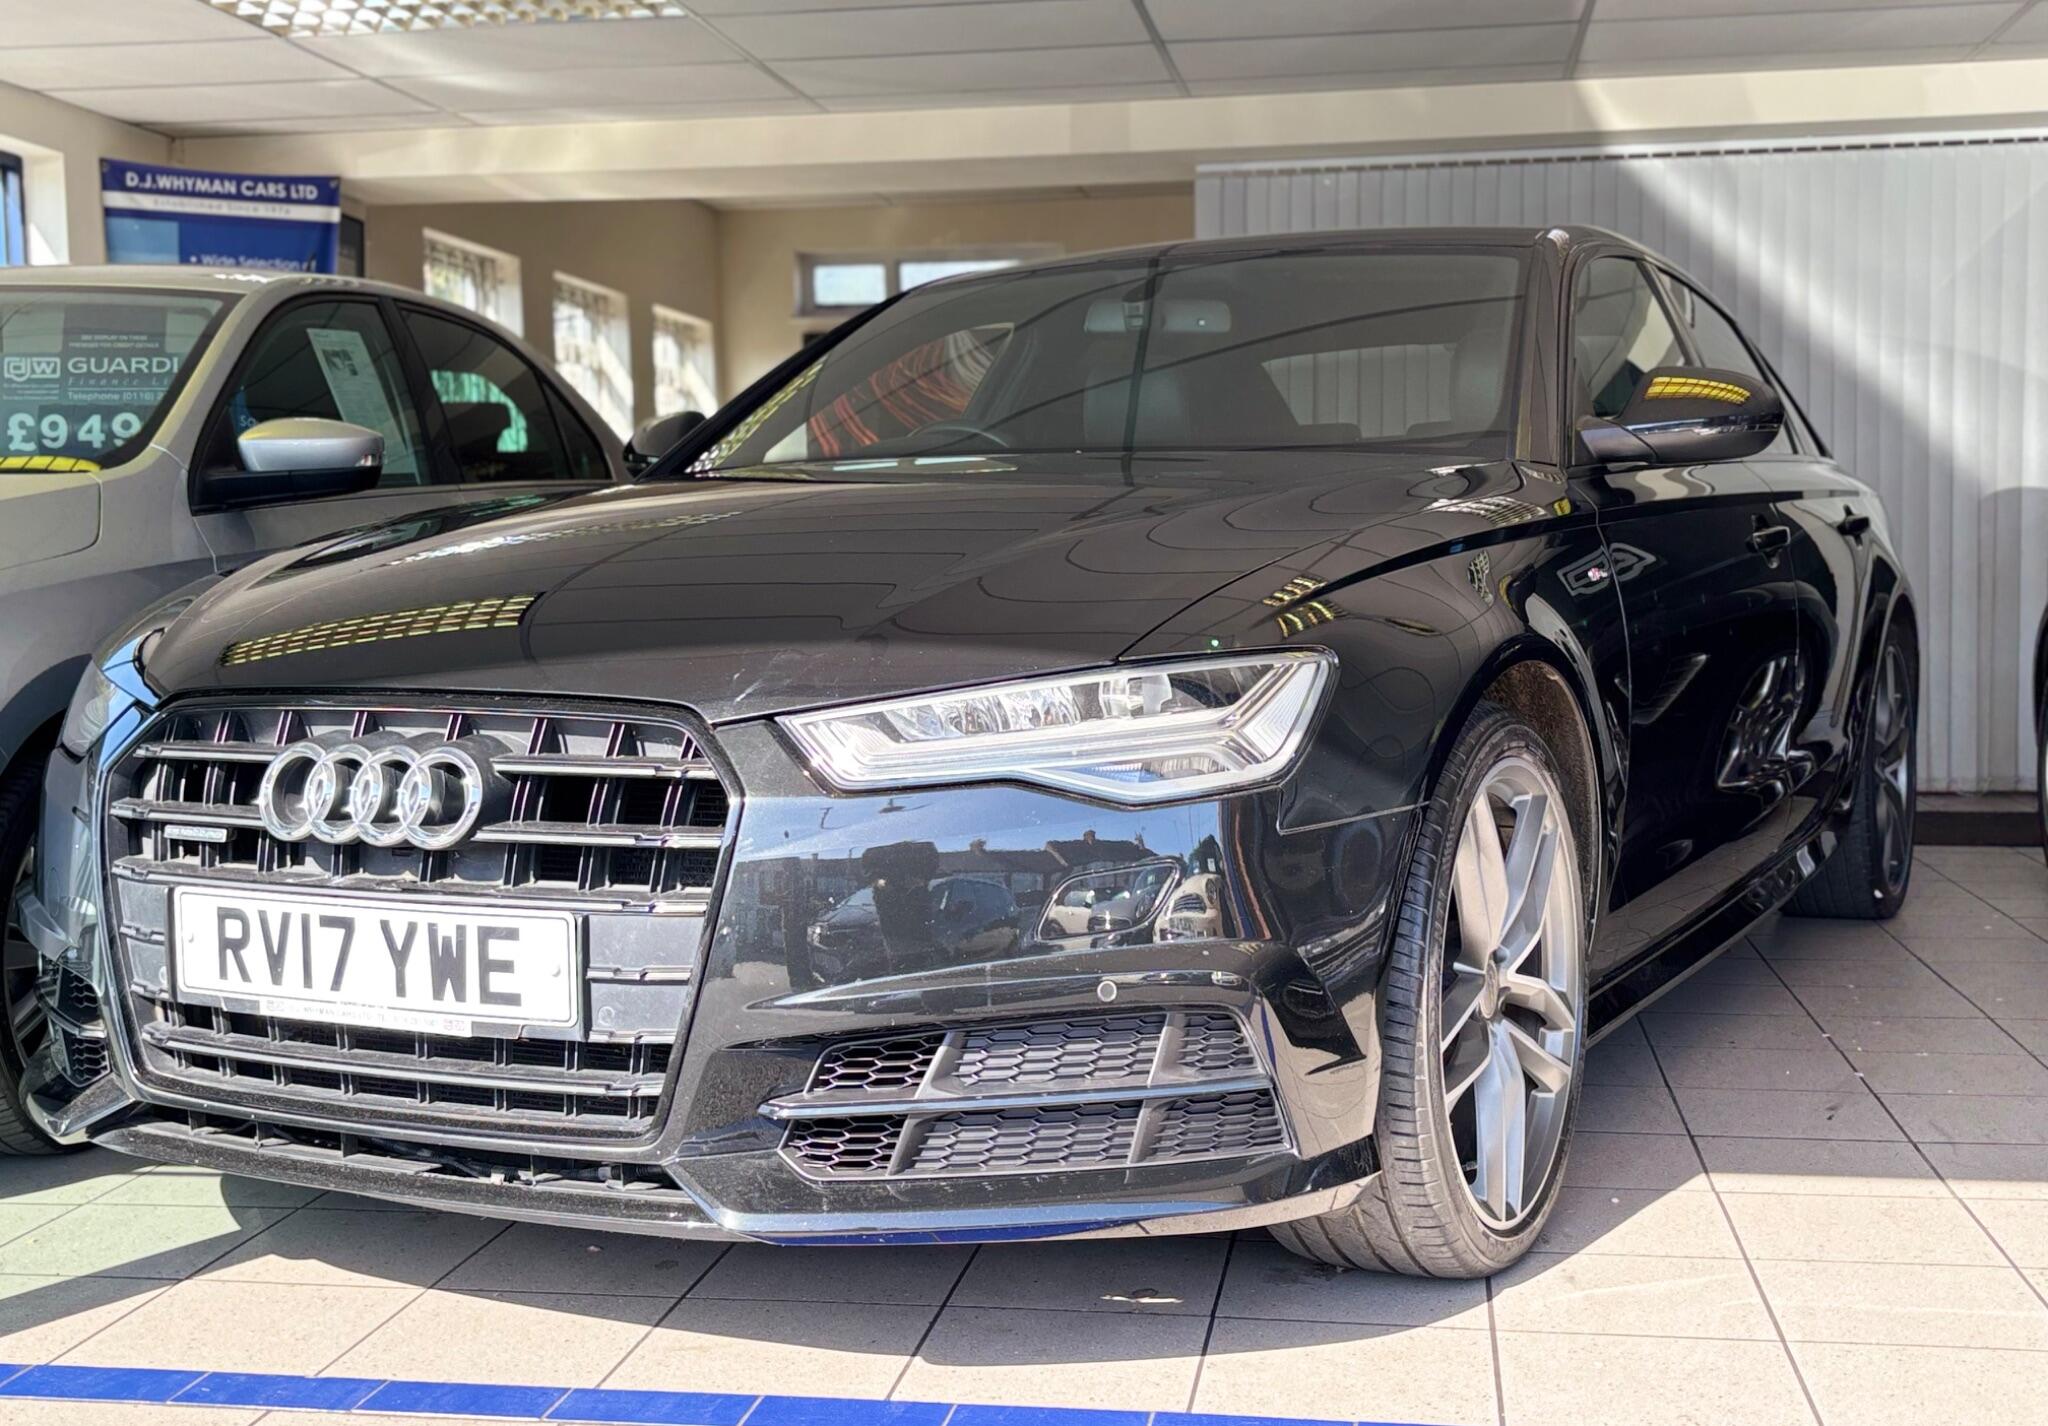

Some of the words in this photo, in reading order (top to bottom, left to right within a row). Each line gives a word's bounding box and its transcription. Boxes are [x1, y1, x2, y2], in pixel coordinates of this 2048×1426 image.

[241, 180, 287, 198] CARS
[290, 183, 318, 199] LTD
[68, 357, 178, 373] GUARDI
[217, 906, 355, 992] RV17
[380, 919, 522, 1007] YWE
